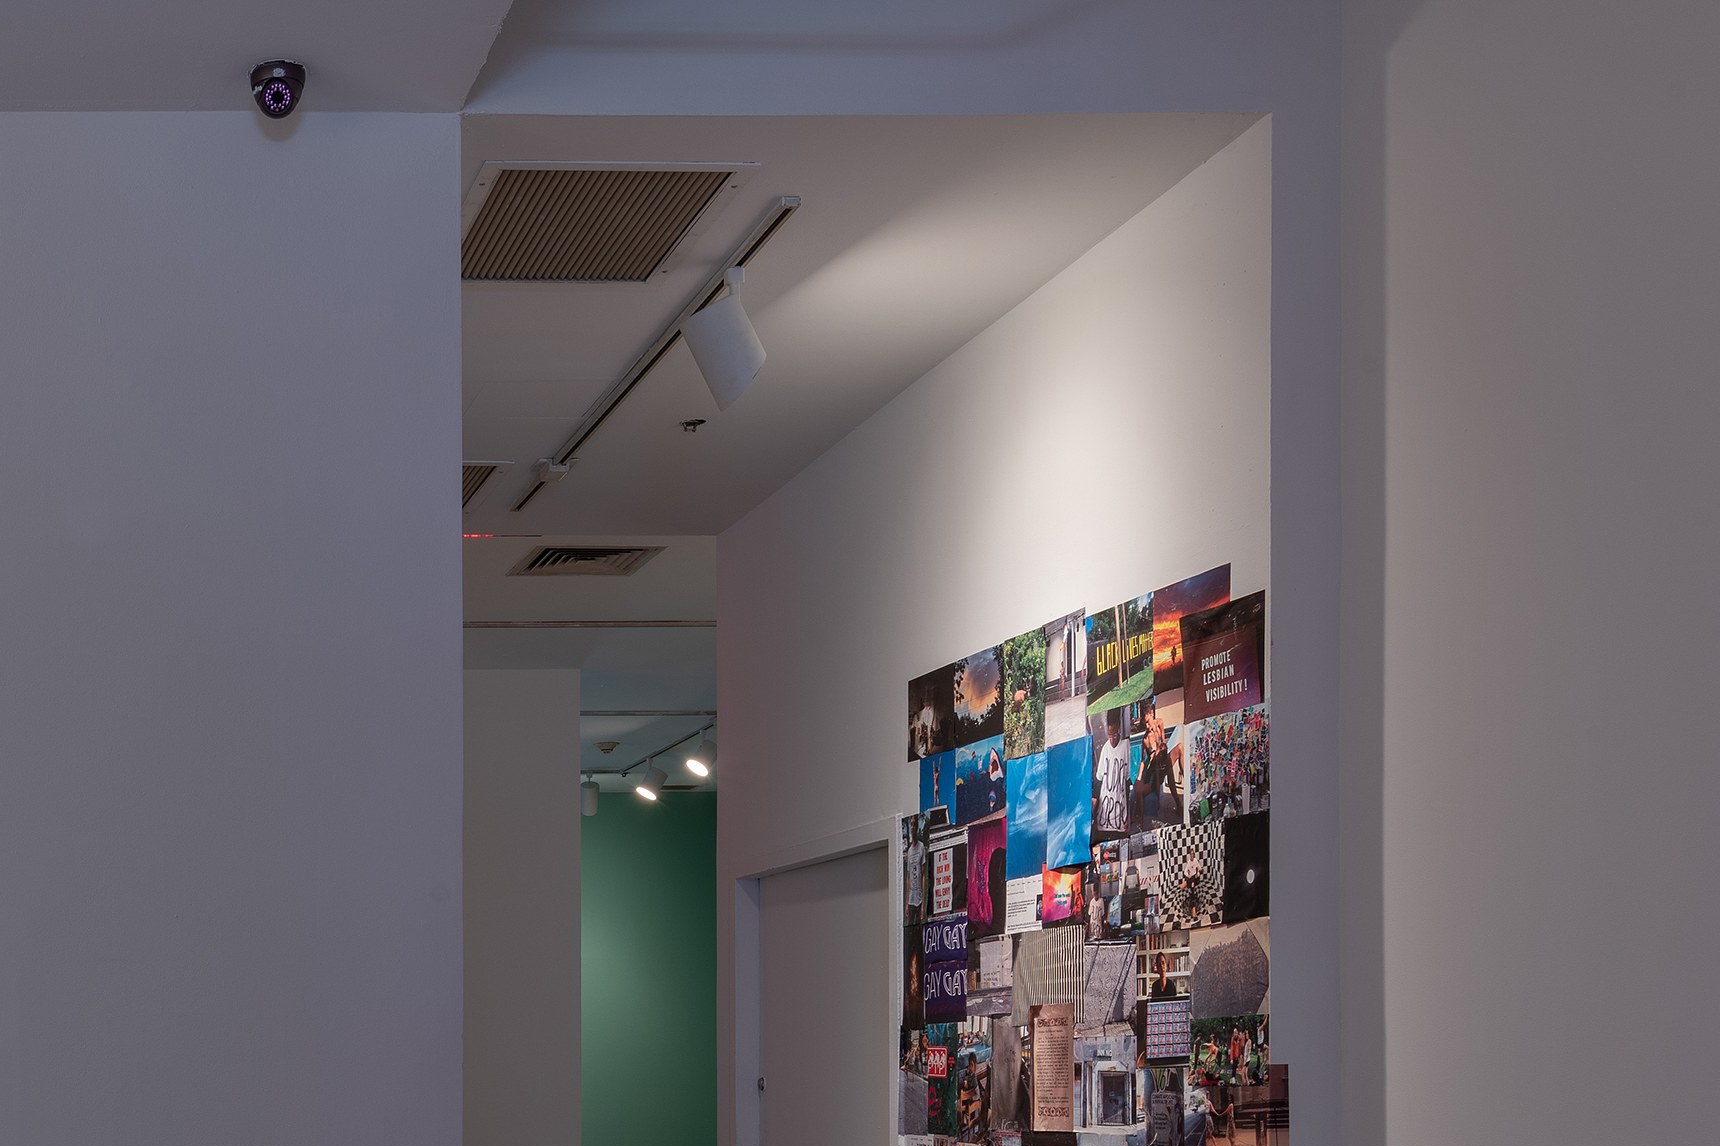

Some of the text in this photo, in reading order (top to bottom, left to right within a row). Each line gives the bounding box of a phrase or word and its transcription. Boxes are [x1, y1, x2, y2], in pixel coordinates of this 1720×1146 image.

[1201, 650, 1231, 671] PROMOTE
[1203, 664, 1235, 686] LESBIAN
[925, 922, 968, 954] GAY GAY
[924, 969, 941, 1001] GAY
[943, 969, 968, 997] GAY
